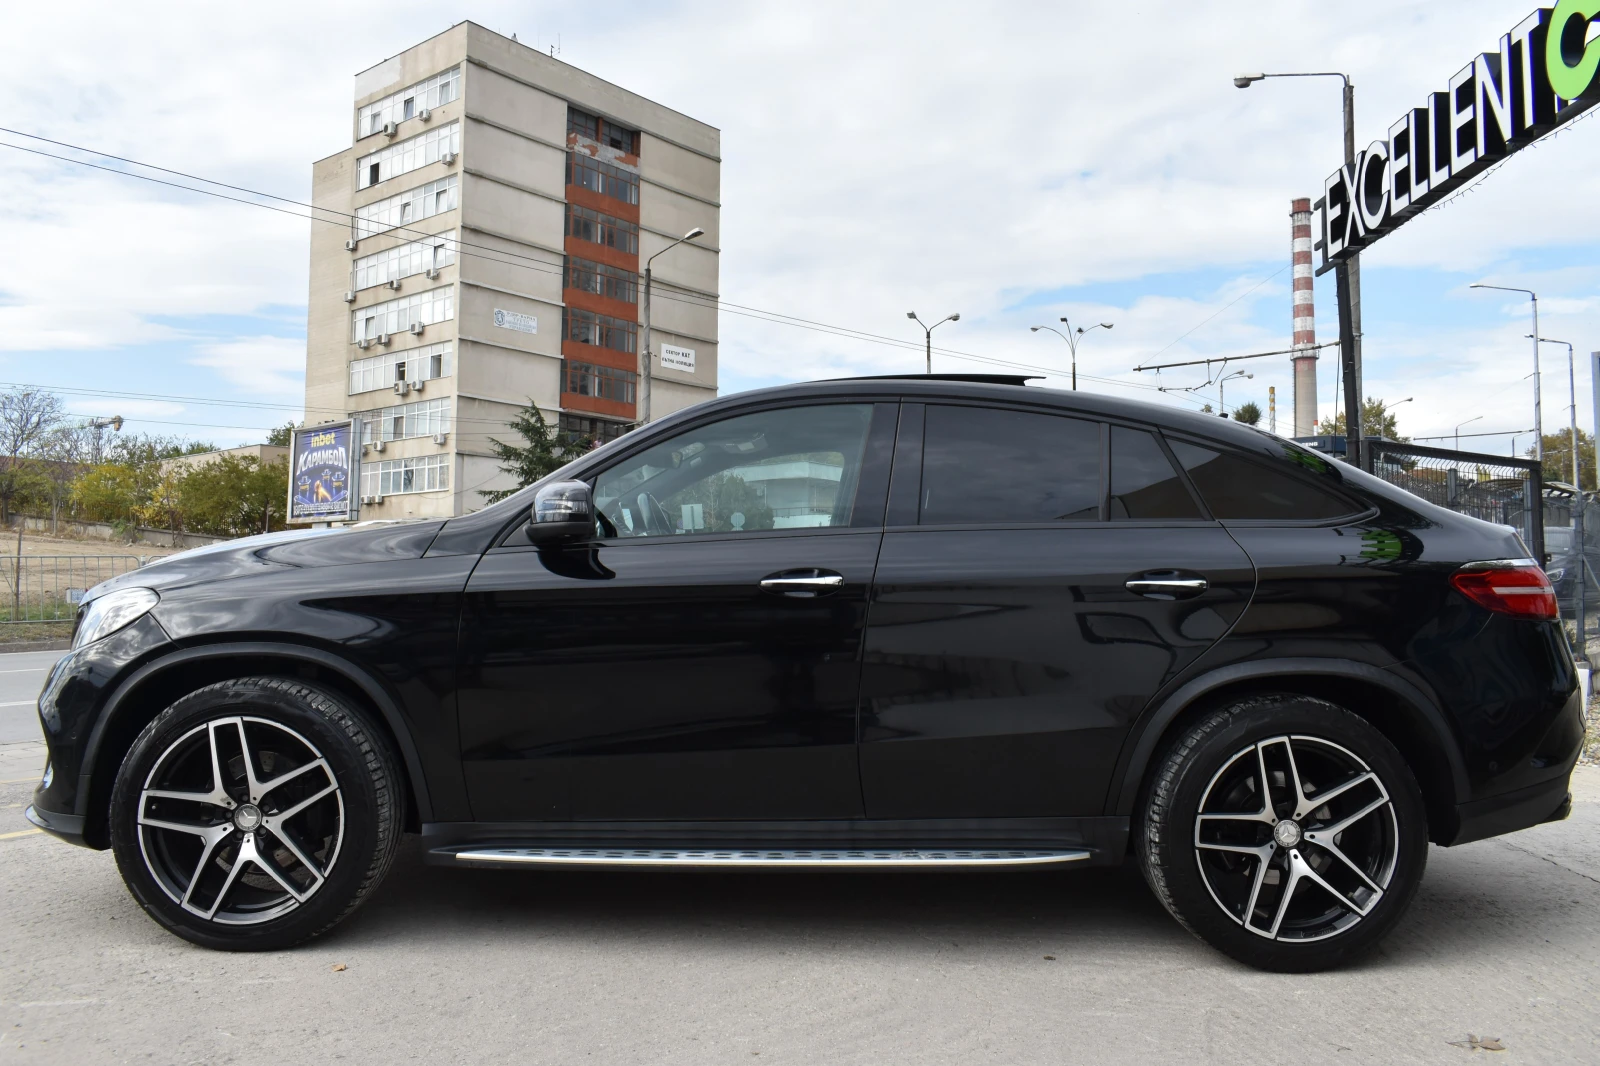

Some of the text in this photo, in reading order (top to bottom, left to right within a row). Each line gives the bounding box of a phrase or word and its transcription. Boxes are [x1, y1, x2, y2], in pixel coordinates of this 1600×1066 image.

[1325, 8, 1541, 259] EXCELLENT
[311, 432, 336, 448] inbet
[296, 446, 348, 476] КАРАМБОЛ
